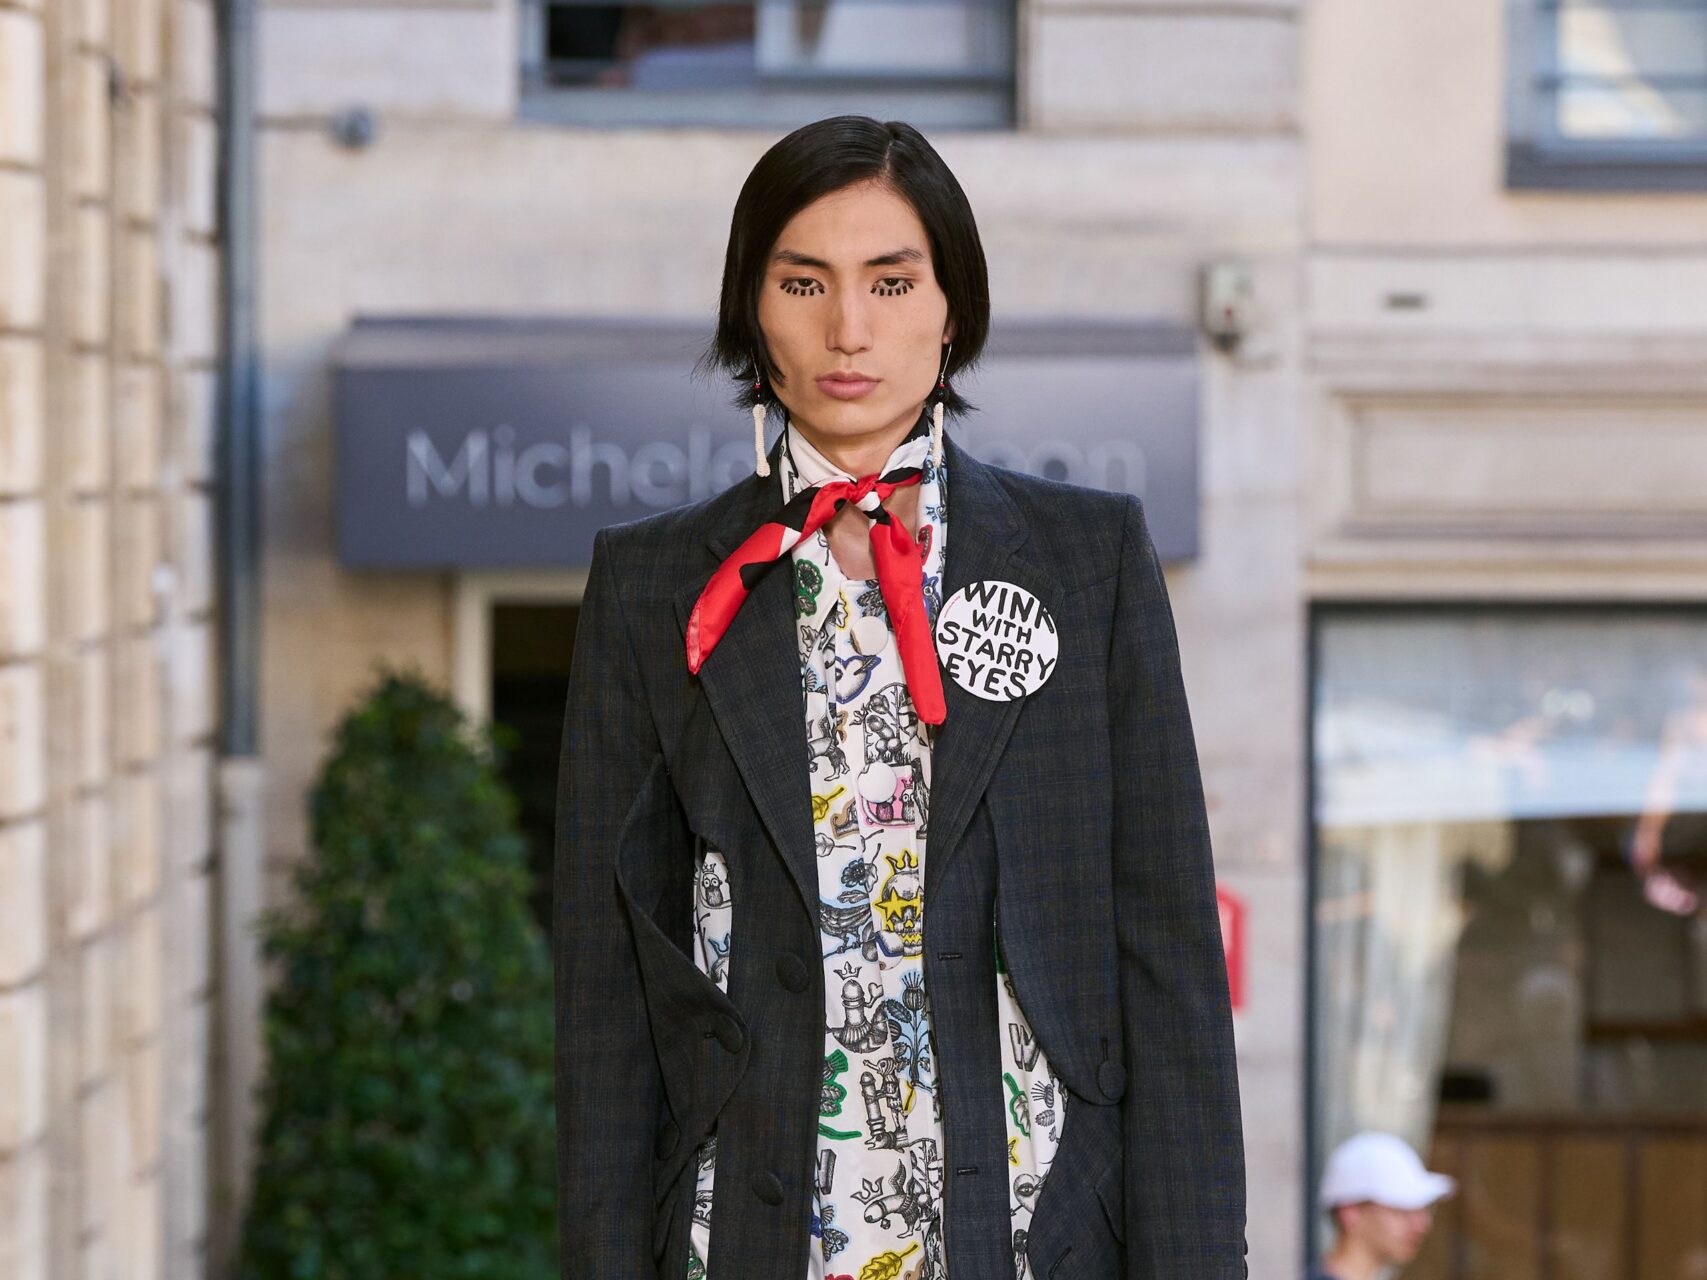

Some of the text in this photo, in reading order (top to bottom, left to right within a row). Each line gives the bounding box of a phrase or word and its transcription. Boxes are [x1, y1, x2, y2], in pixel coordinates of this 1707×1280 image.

[973, 609, 1032, 644] WITH
[938, 621, 1055, 680] STARRY
[946, 653, 1027, 700] EYES
